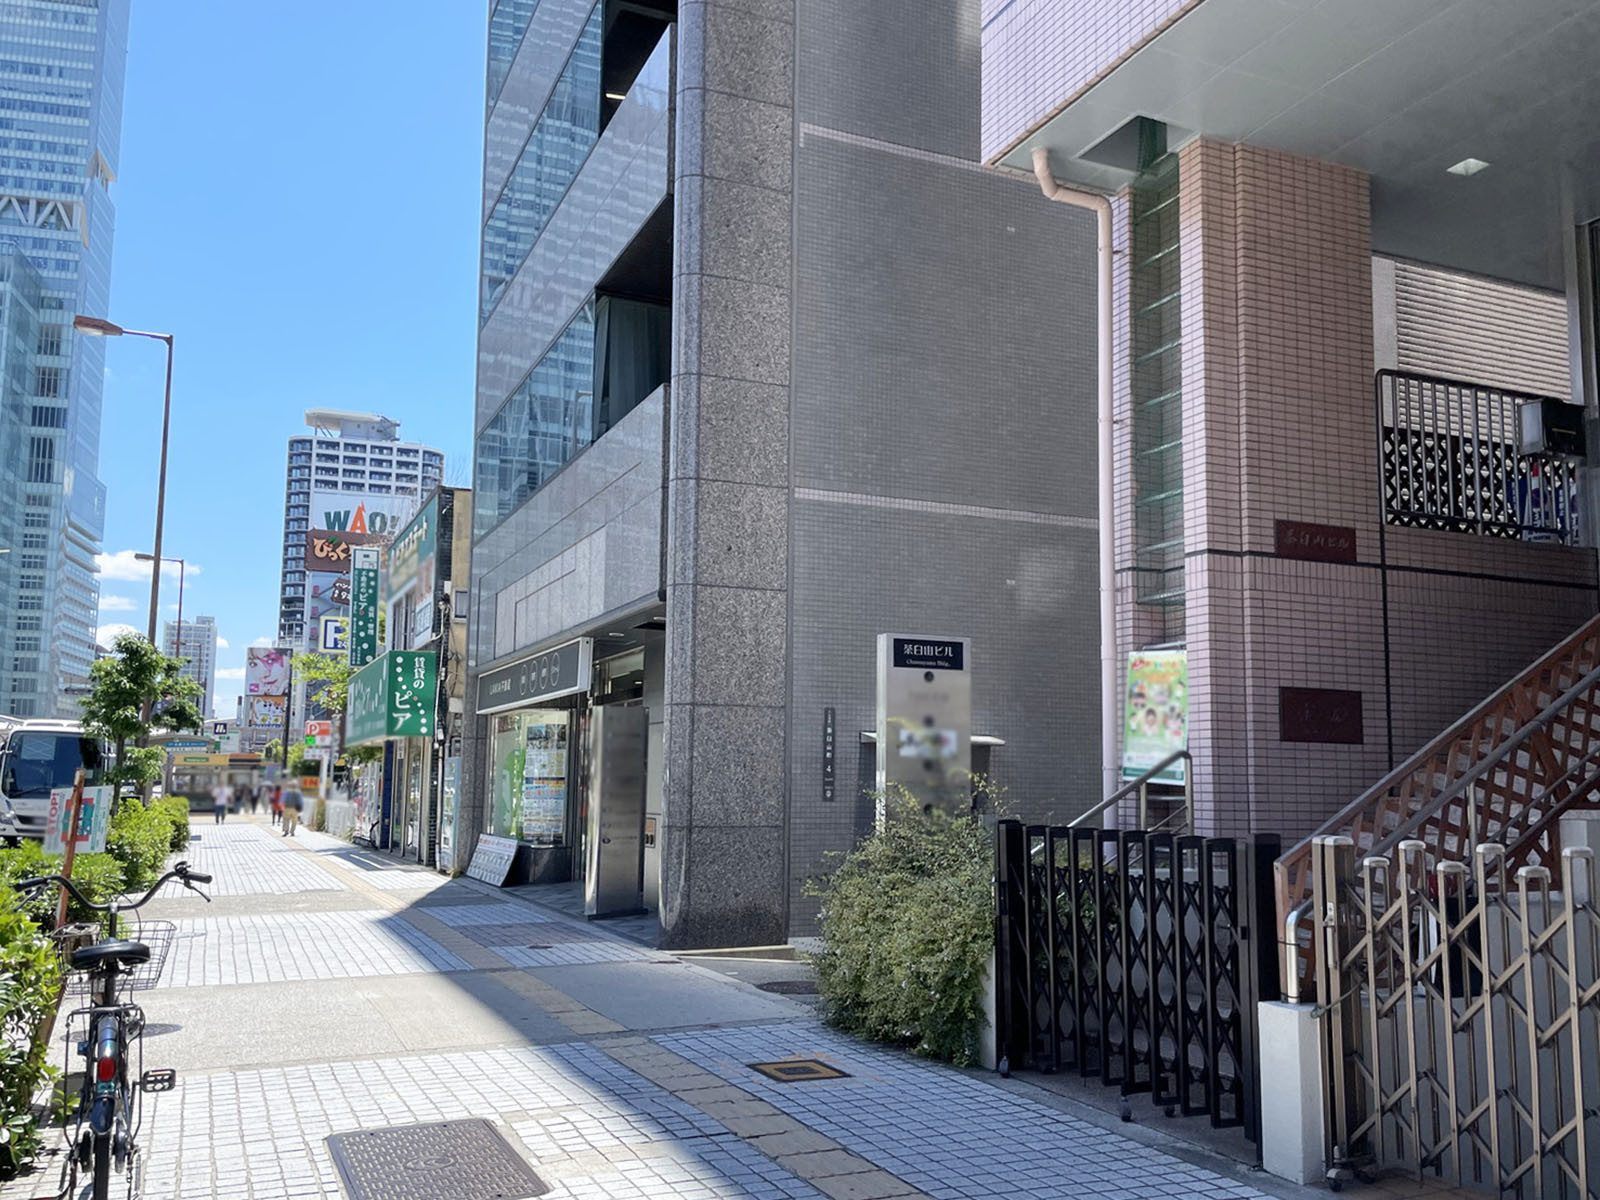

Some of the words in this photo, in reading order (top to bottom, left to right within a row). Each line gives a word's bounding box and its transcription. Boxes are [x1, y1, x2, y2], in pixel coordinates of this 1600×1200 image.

[313, 537, 352, 561] びっく
[412, 656, 426, 690] 賃貸の
[392, 690, 413, 733] ピア
